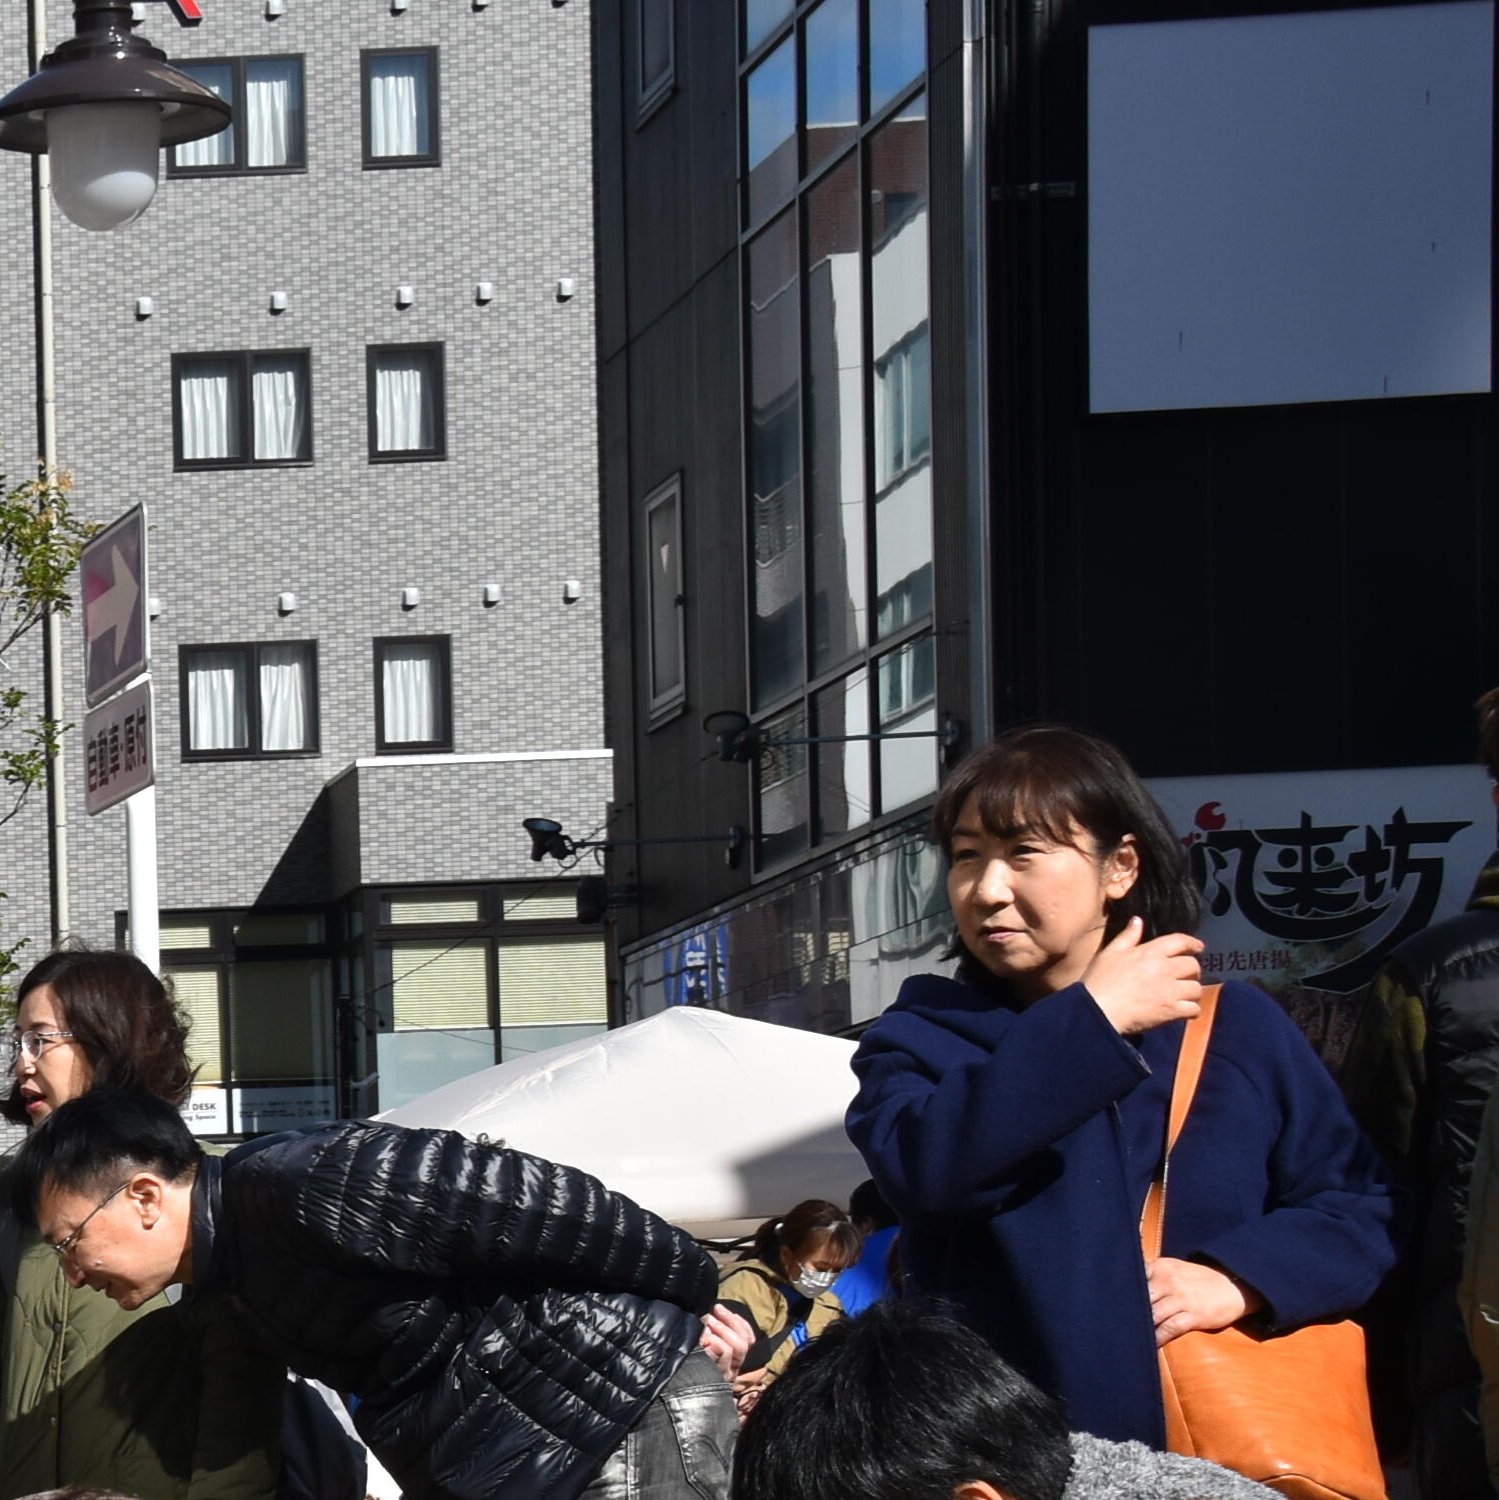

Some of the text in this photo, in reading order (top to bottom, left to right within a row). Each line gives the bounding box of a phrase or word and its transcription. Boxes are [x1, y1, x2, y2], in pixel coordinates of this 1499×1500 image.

[1203, 949, 1292, 974] 羽先唐揚
[192, 1102, 217, 1111] DESK
